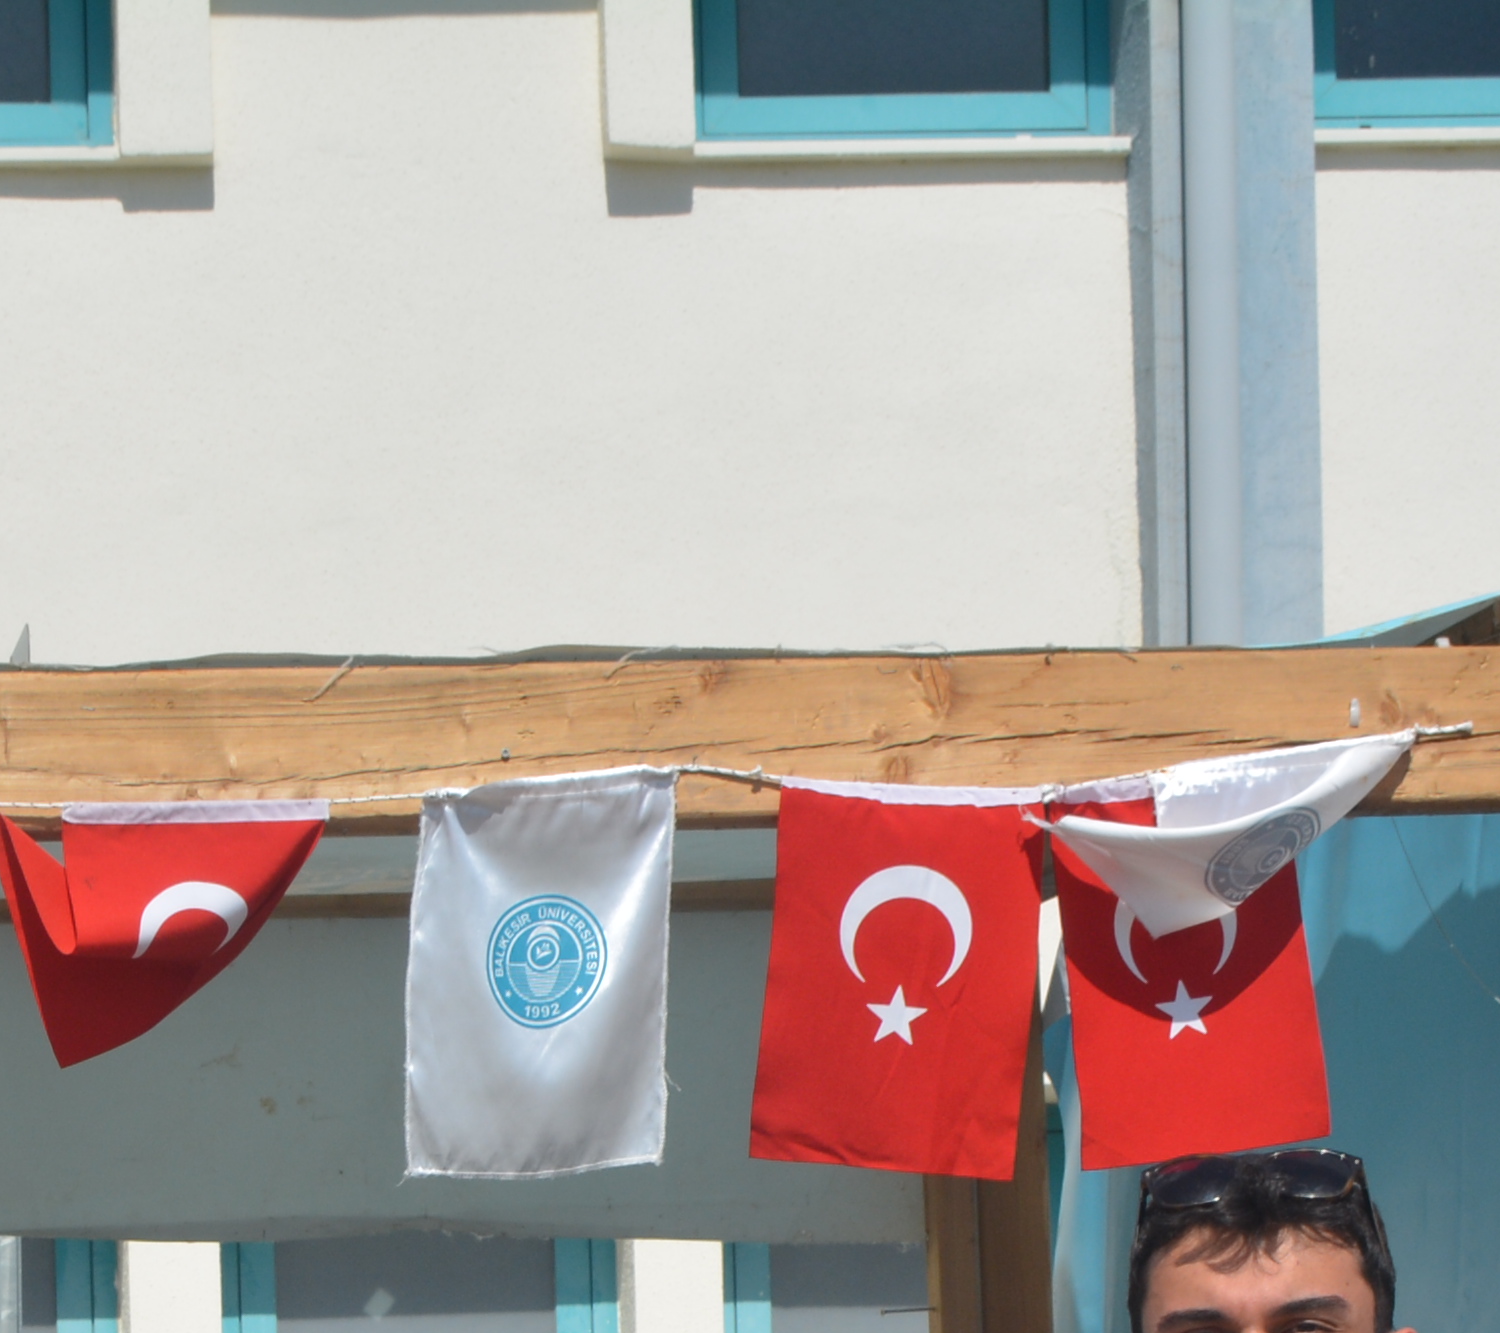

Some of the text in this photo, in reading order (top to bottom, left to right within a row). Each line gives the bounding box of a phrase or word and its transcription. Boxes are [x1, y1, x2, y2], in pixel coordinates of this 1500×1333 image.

[494, 906, 597, 978] BALIKESİR ÜNİVERSİTESİ
[524, 1003, 561, 1018] 1992
